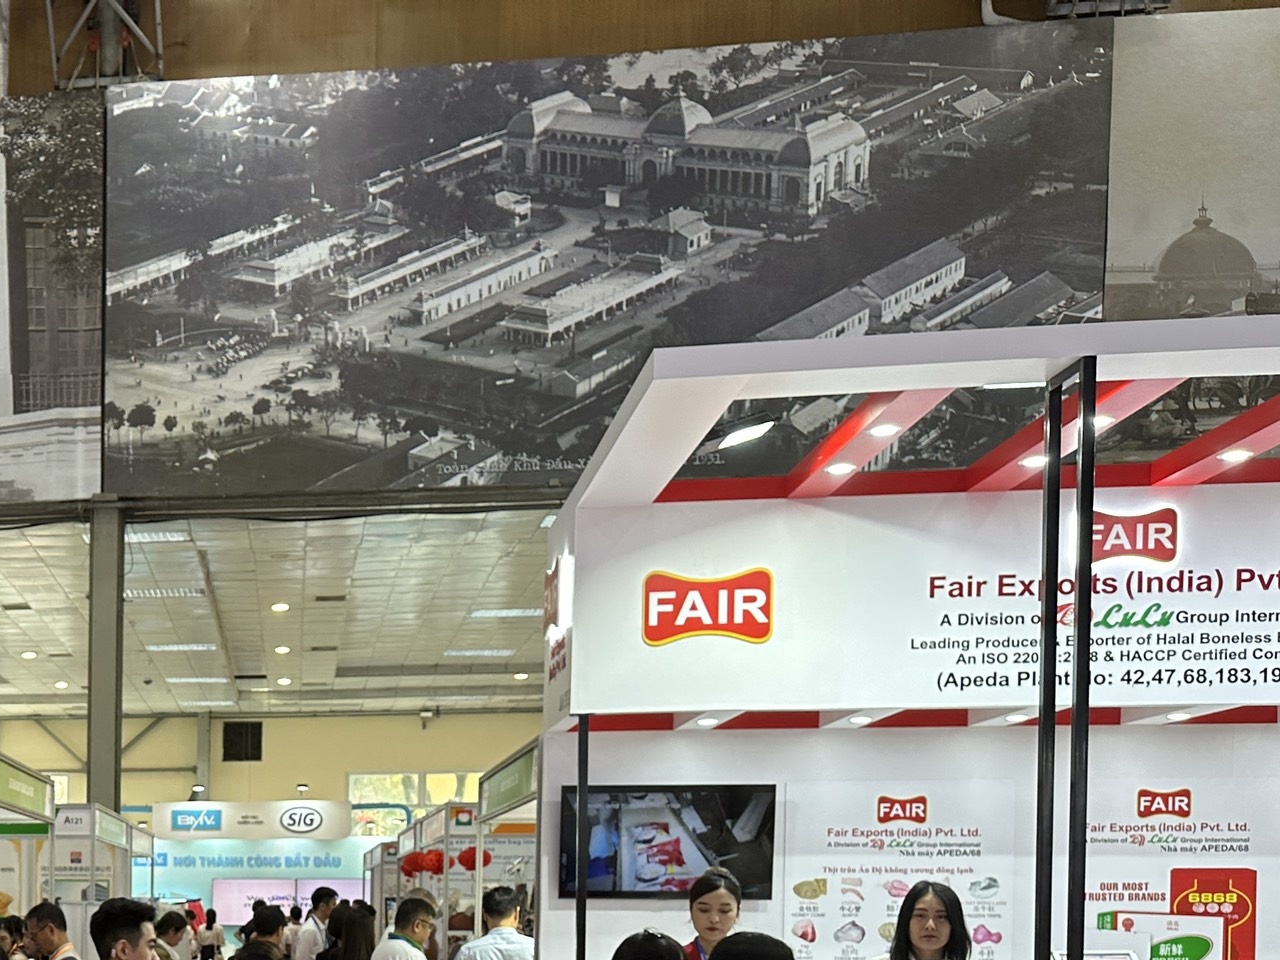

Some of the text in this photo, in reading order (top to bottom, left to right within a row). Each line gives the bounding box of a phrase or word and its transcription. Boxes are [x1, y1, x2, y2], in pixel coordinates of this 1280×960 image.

[929, 575, 987, 599] Fair
[1125, 568, 1224, 600] (India)
[648, 588, 769, 627] FAIR
[940, 613, 952, 627] A
[957, 610, 1025, 627] Division
[1031, 614, 1042, 626] o
[1093, 603, 1175, 629] LuLu
[1176, 609, 1230, 628] Group
[911, 638, 970, 653] Leading
[975, 636, 1041, 650] Produce
[1137, 633, 1153, 646] of
[1156, 632, 1195, 646] Halal
[1200, 631, 1273, 645] Boneless
[956, 654, 977, 665] An
[981, 652, 1008, 665] ISO
[1104, 650, 1115, 663] &
[1119, 649, 1177, 662] HACCP
[1182, 648, 1247, 662] Certified
[936, 672, 1010, 690] (Apeda
[1018, 671, 1071, 687] Plnt
[1088, 670, 1113, 686] o:
[879, 803, 926, 818] FAIR
[1140, 796, 1189, 812] FAIR
[64, 816, 83, 825] A121
[287, 812, 315, 827] SIG
[827, 828, 982, 839] Fair Exports (India) Pvt. Ltd.
[1110, 822, 1156, 834] Exports
[1159, 822, 1197, 834] (India)
[1201, 822, 1223, 832] Pvt.
[1228, 822, 1251, 832] Ltd.
[936, 849, 982, 857] APEDA/68
[247, 854, 282, 868] CÔNG
[1100, 882, 1149, 891] OUR MOST
[1128, 893, 1166, 902] BRANDS
[1188, 892, 1238, 904] 6868
